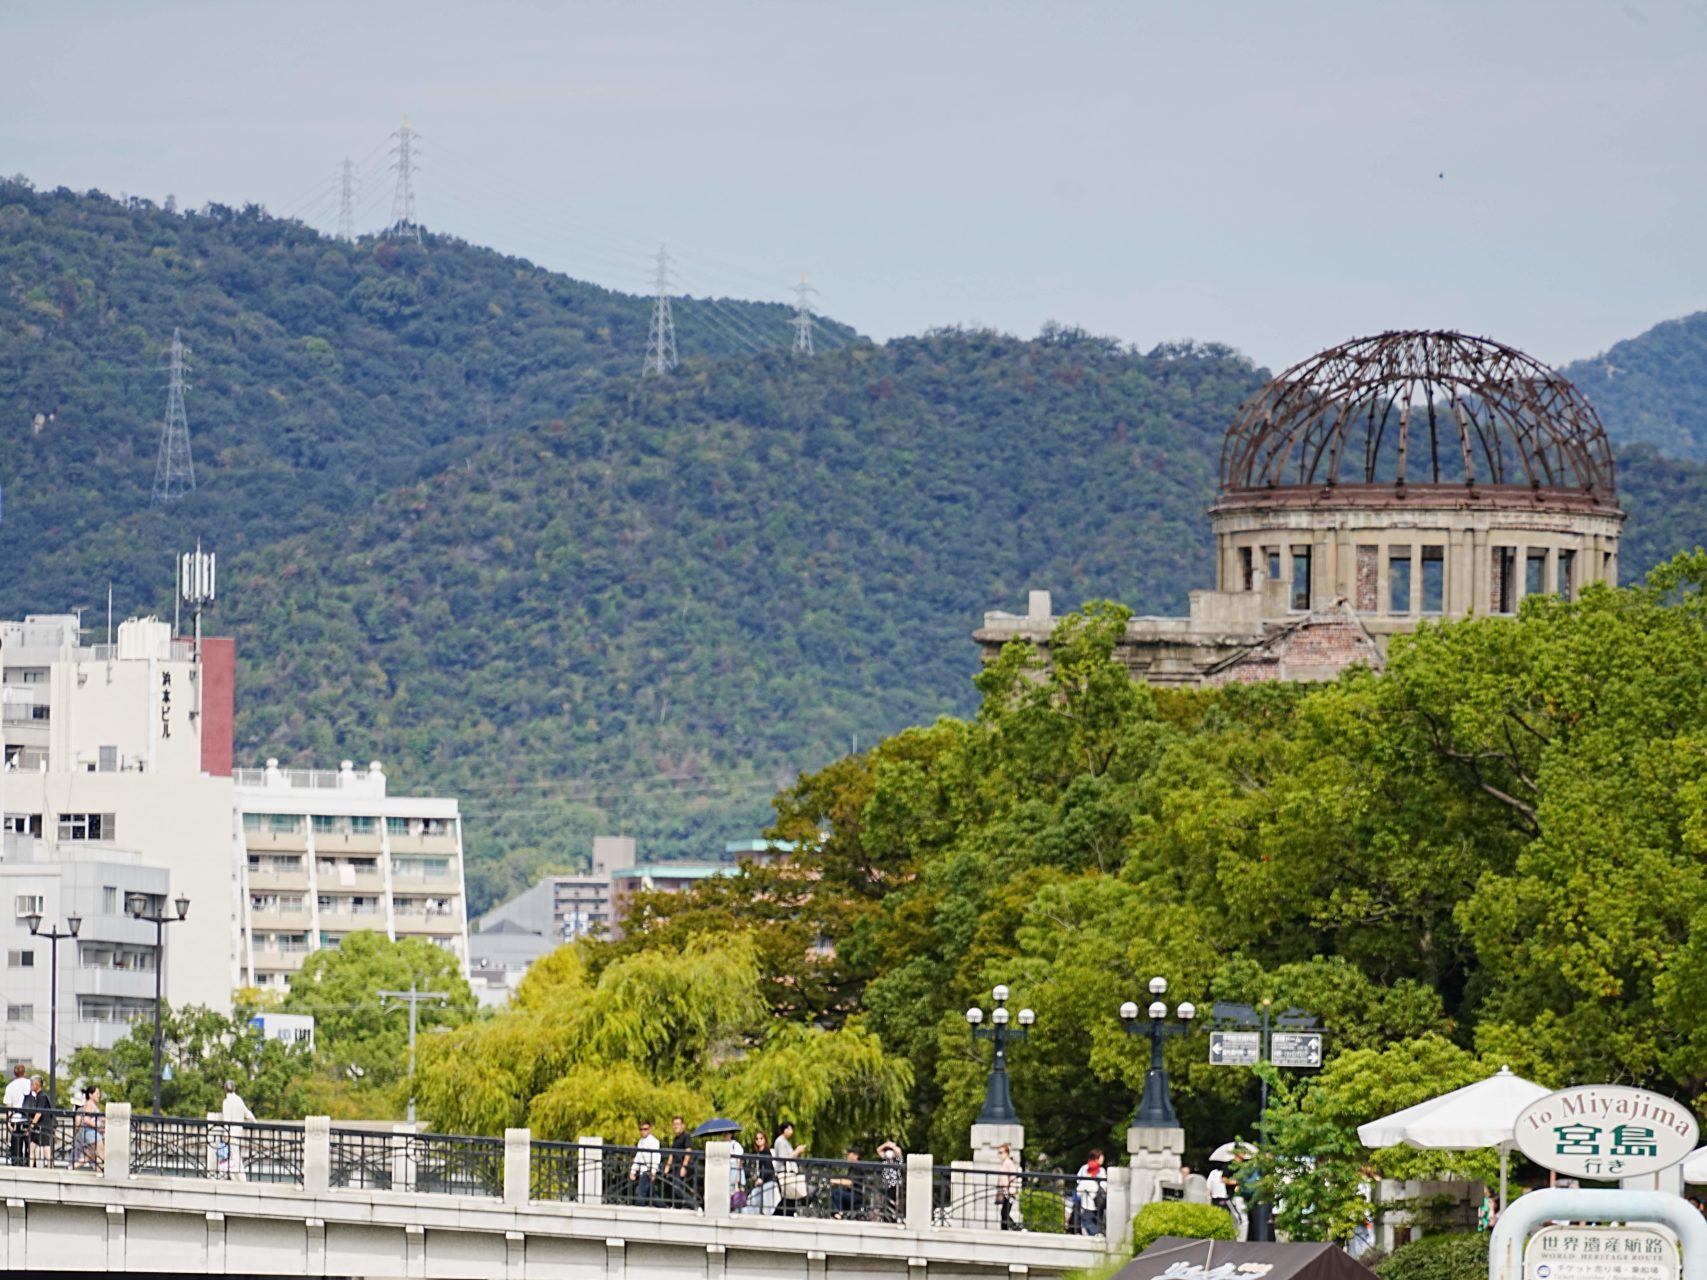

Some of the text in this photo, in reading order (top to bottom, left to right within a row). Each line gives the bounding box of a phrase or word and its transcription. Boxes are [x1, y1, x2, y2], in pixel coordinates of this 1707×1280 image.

[1524, 1092, 1690, 1138] To Miyajima
[1553, 1123, 1657, 1157] 宮島
[1584, 1158, 1625, 1174] 行き
[1543, 1236, 1663, 1254] 世界遺産航路
